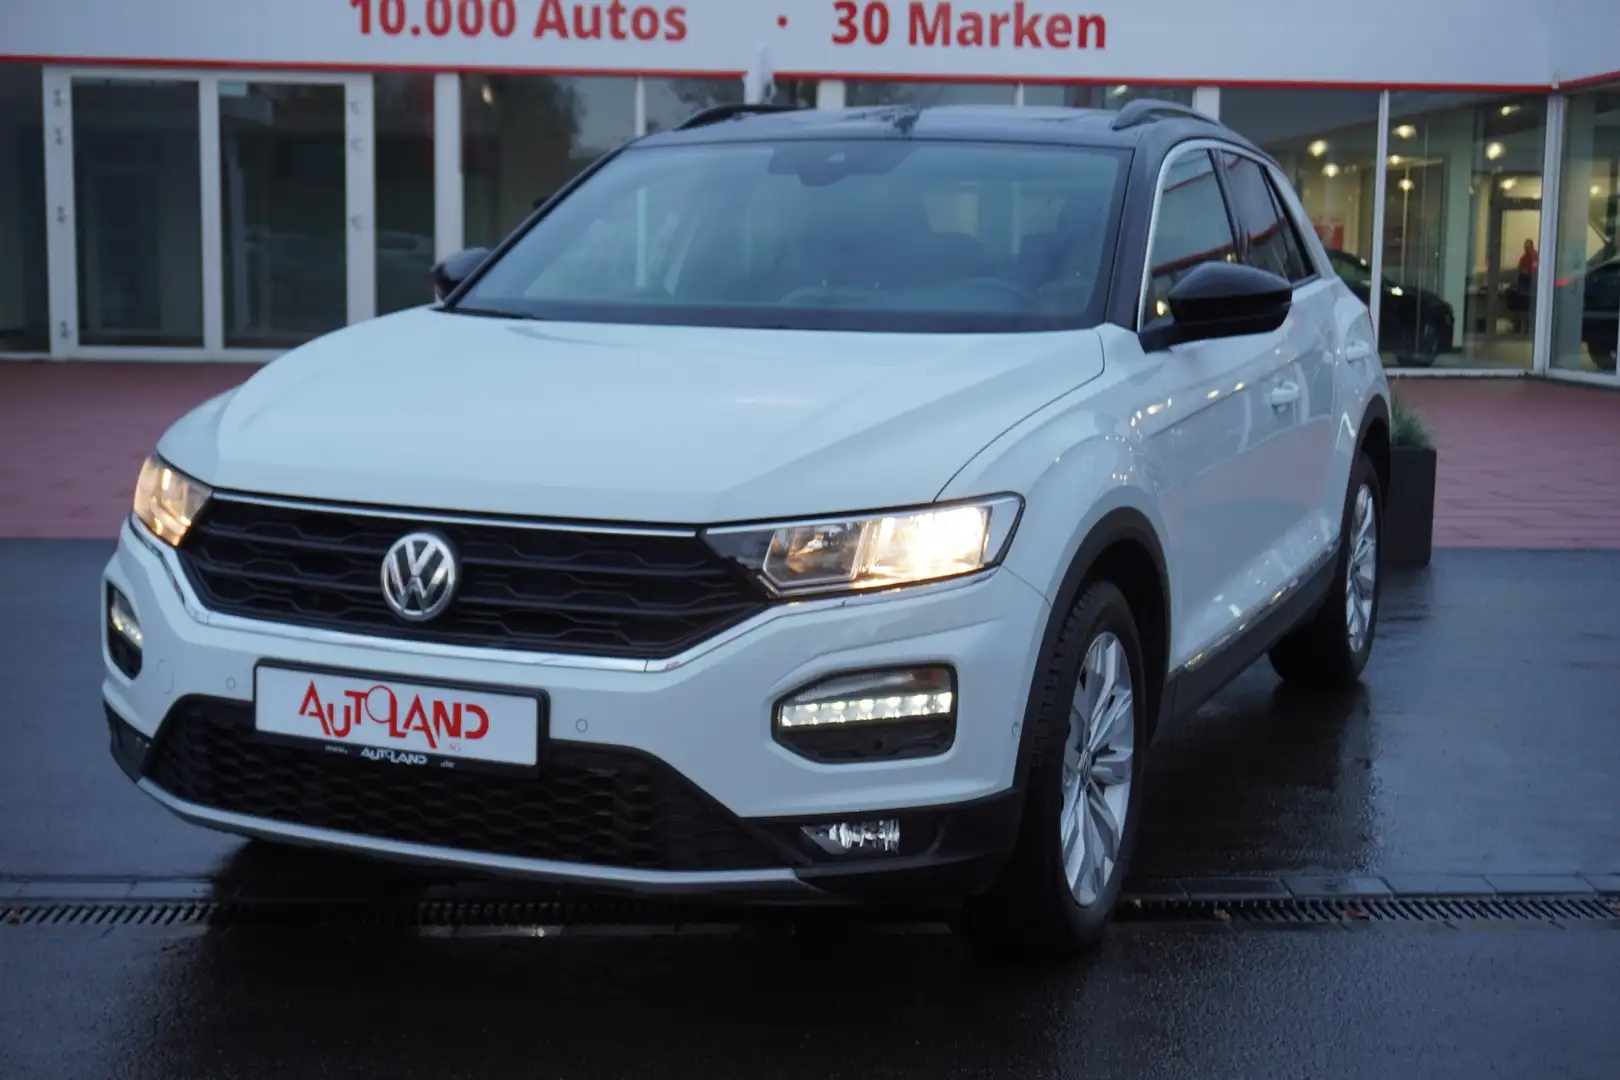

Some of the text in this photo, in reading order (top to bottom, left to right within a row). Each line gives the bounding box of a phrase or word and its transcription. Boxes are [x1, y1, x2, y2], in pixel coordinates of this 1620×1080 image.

[349, 0, 1106, 49] 10.000 Autos 30 Marken
